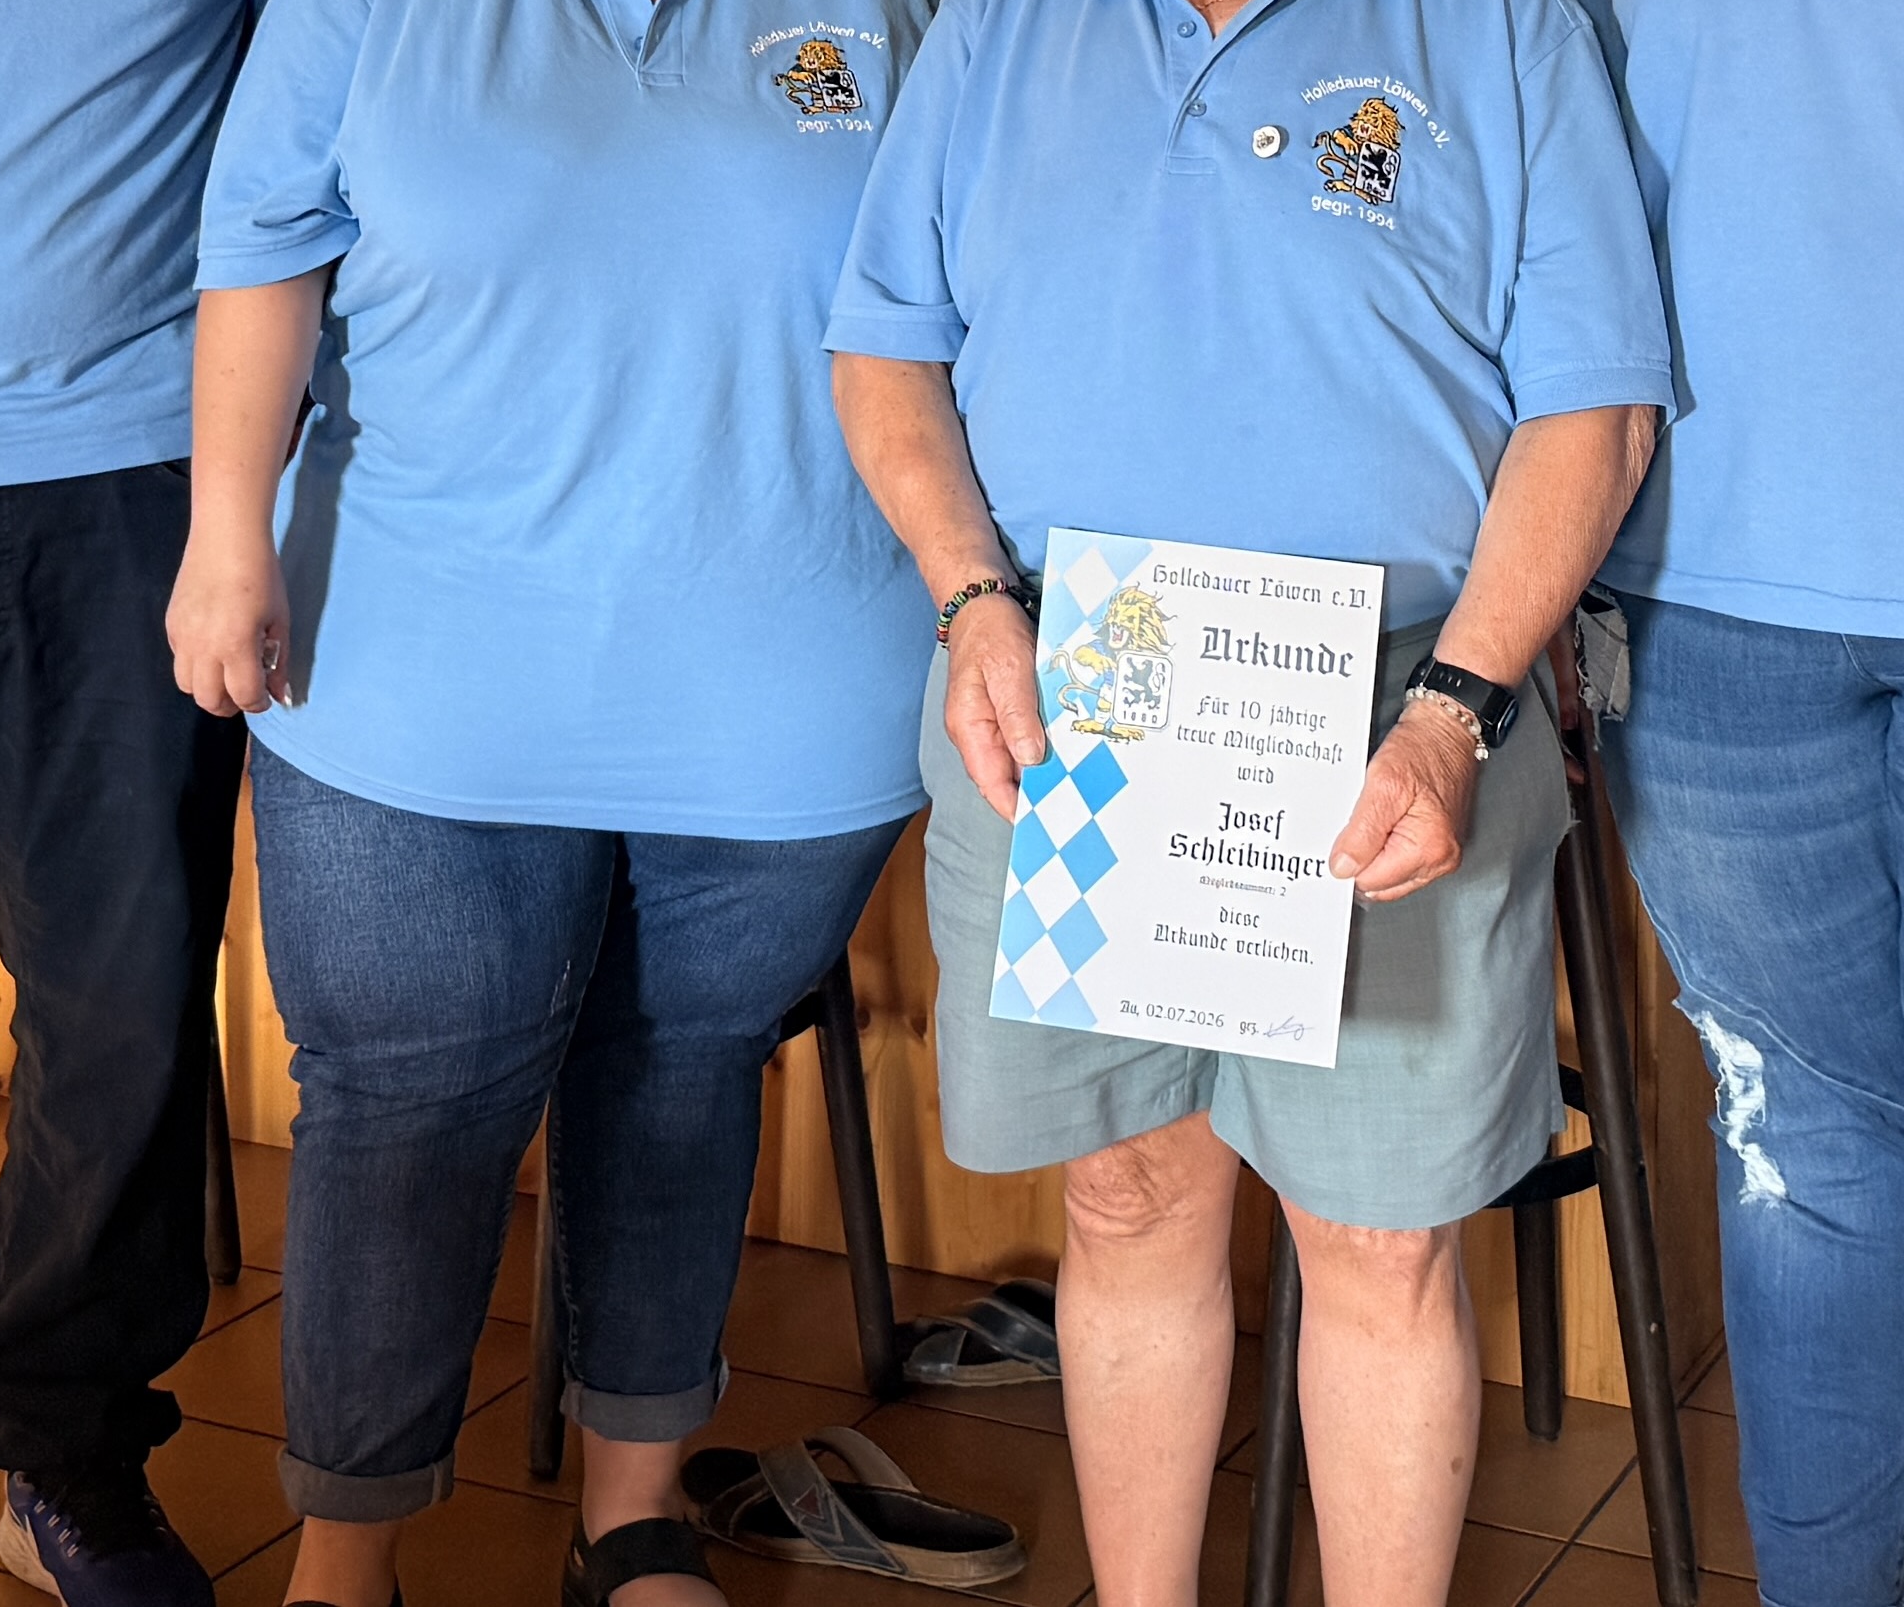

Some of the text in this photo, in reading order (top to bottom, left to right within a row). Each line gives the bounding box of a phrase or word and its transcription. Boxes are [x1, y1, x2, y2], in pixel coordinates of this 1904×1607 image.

[859, 31, 886, 50] e.V.
[1300, 75, 1450, 149] Holledauer Löwen e.V.
[1311, 194, 1396, 231] gegr. 1994
[1153, 564, 1372, 610] Holledauer Löwen e.V.
[1199, 625, 1355, 678] Urkunde
[1197, 695, 1328, 732] Für 10 jährige
[1177, 723, 1344, 765] treue Mitgliedschaft
[1237, 763, 1275, 785] wird
[1218, 802, 1286, 840] Josef
[1168, 833, 1325, 881] Schleibinger
[1279, 886, 1286, 897] 2
[1219, 906, 1260, 929] diese
[1154, 924, 1314, 966] Urkunde verliehen.
[1119, 1000, 1140, 1018] Au,
[1145, 1003, 1225, 1028] 02.07.2026
